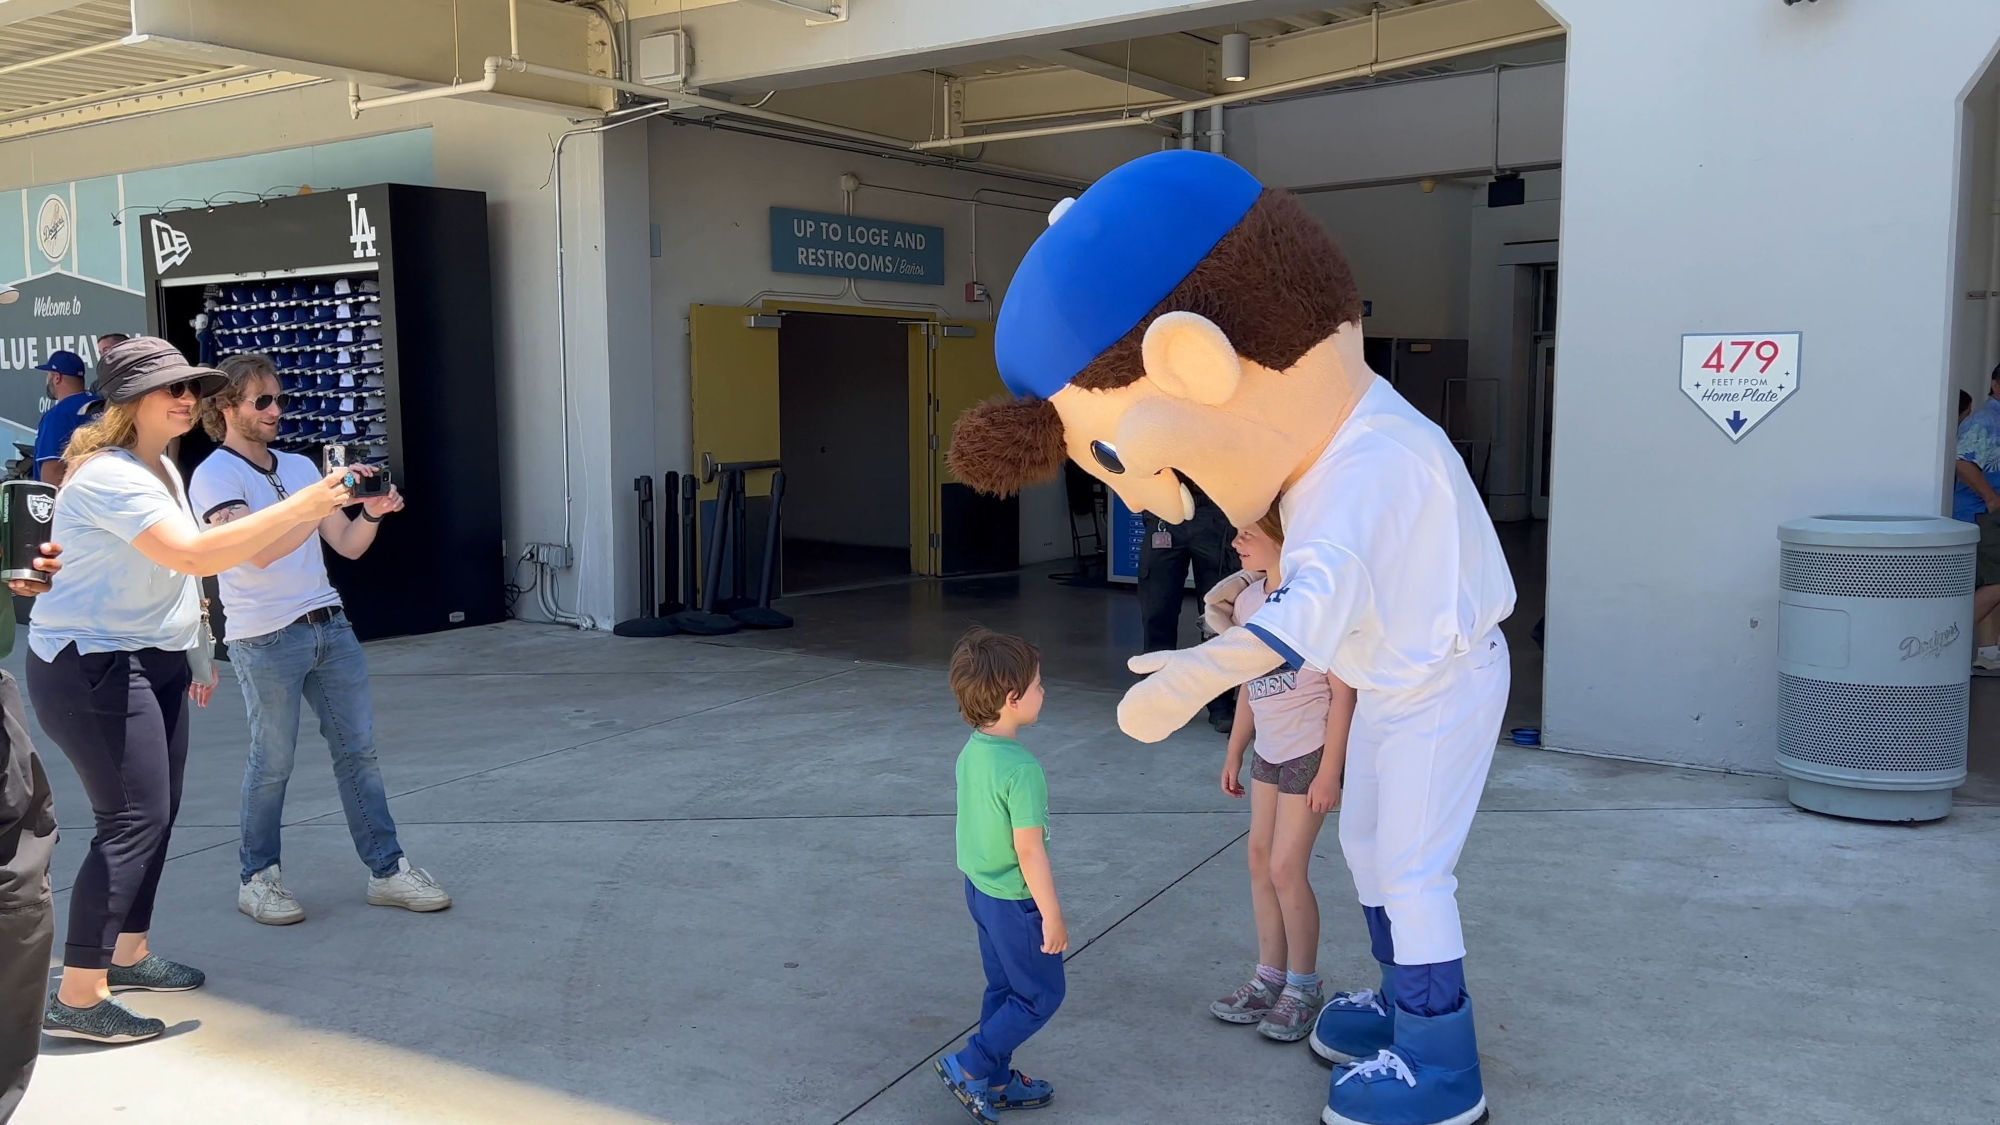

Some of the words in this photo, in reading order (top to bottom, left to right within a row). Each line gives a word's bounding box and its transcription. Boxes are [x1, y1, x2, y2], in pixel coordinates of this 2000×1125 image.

[793, 218, 816, 239] UP
[820, 222, 842, 242] TO
[847, 225, 889, 247] LOGE
[894, 232, 926, 250] AND
[33, 296, 72, 318] Welcome
[72, 295, 81, 315] to
[1701, 340, 1779, 374] 479
[1711, 378, 1734, 387] FEET
[1701, 388, 1740, 403] Home
[1741, 388, 1779, 403] Plate
